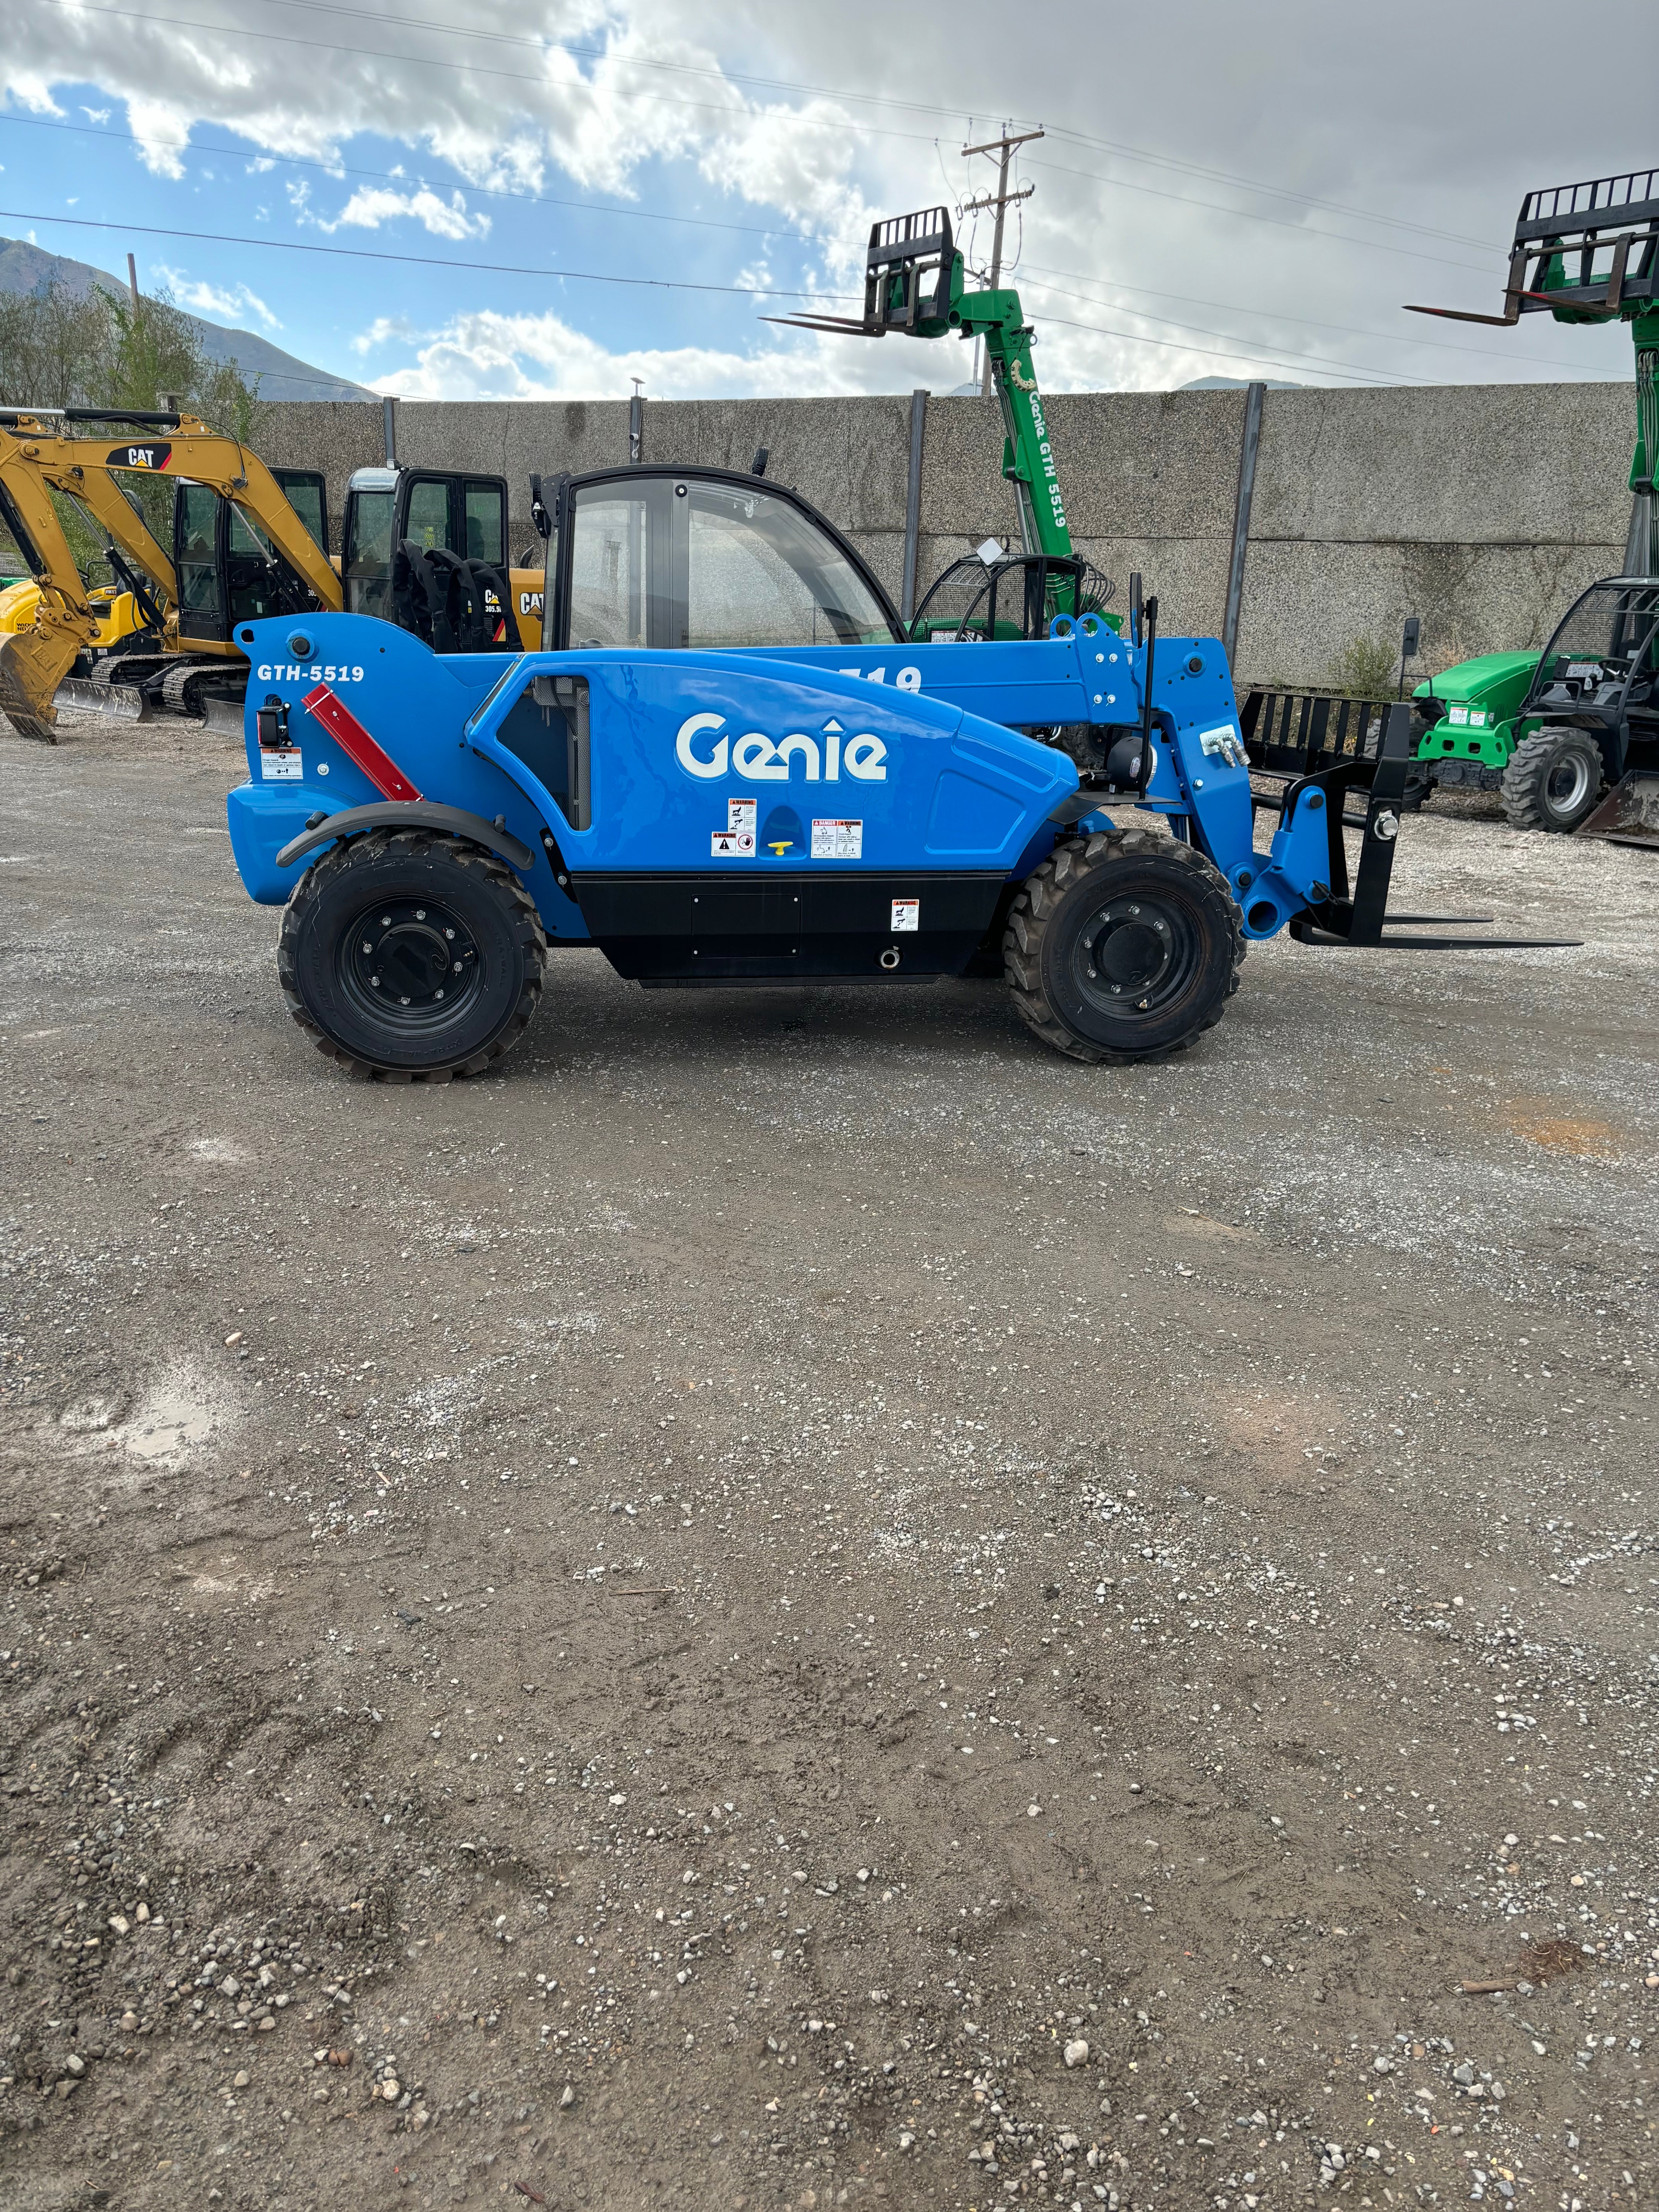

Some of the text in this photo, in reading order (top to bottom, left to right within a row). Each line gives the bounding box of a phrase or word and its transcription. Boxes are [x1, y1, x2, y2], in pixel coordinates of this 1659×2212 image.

[128, 448, 154, 468] CAT
[1029, 391, 1066, 527] Genie GTH 5519
[485, 589, 498, 603] CA
[258, 665, 364, 682] GTH-5519
[676, 713, 887, 780] Genie
